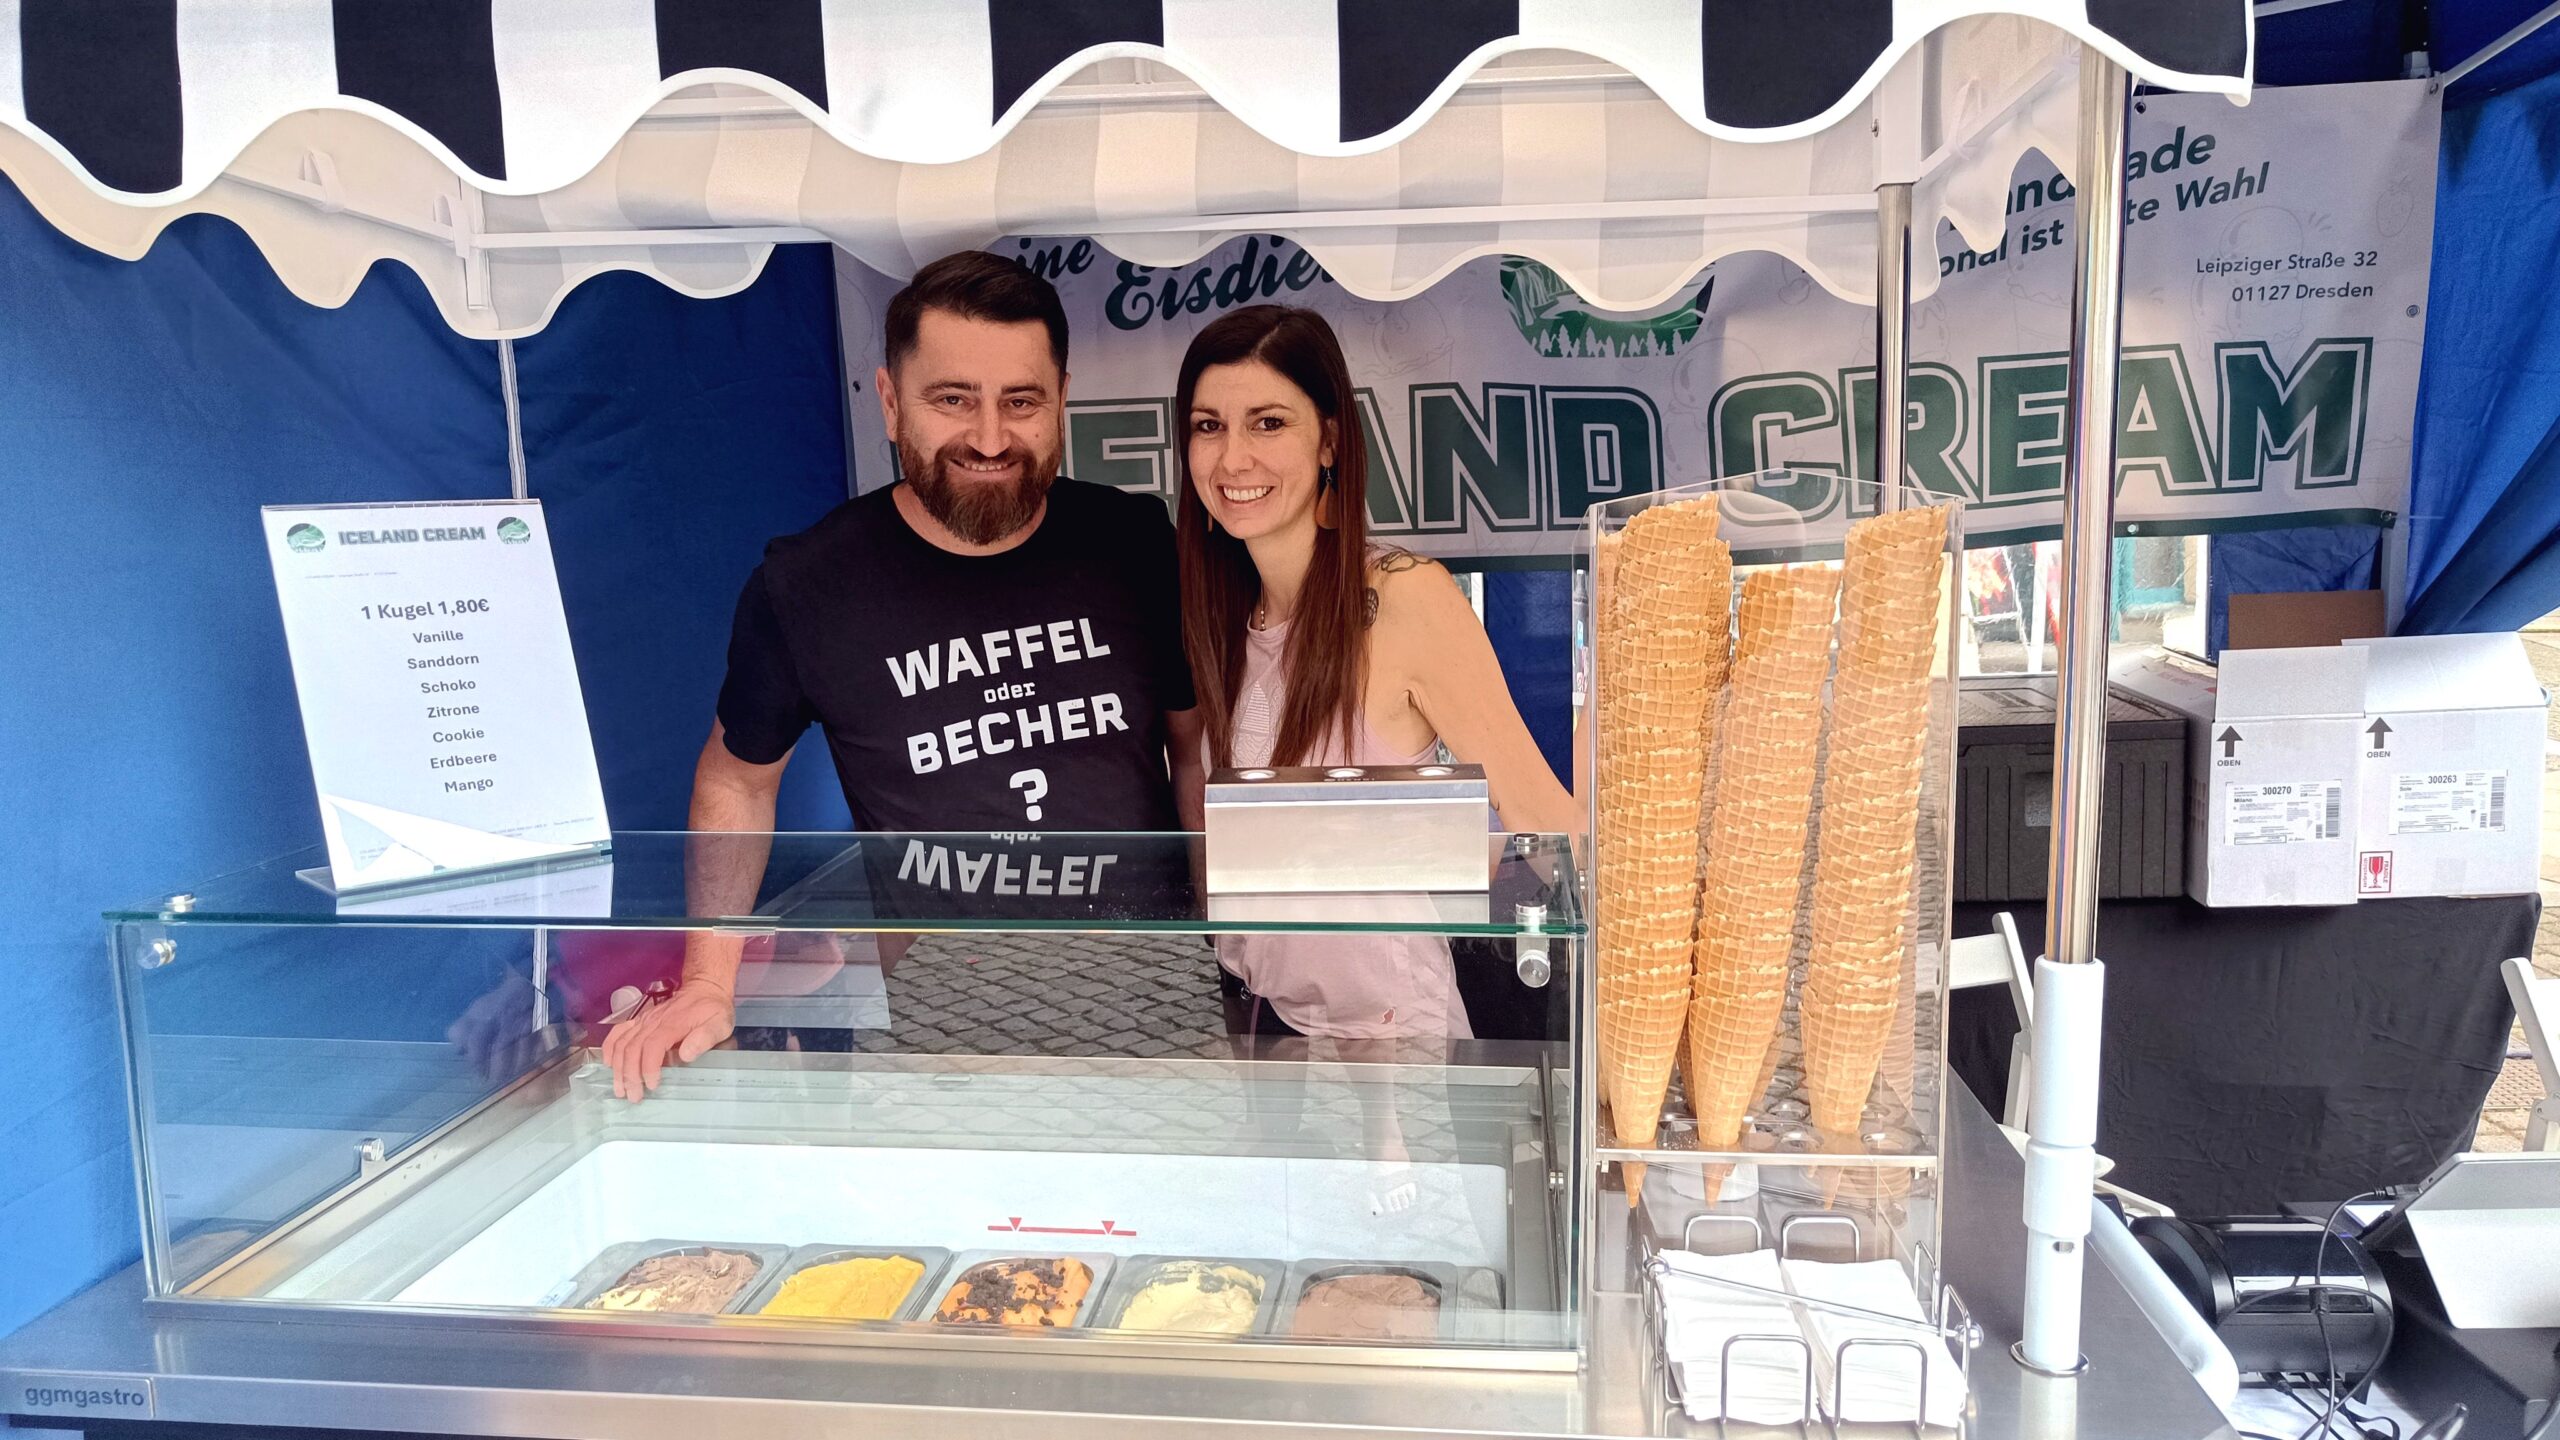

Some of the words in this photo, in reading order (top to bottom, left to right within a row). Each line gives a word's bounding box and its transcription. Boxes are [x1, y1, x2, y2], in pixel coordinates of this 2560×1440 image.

[1940, 229, 2009, 278] onal
[2021, 219, 2065, 255] ist
[2175, 161, 2270, 212] Wahl
[1015, 237, 1096, 279] ine
[2196, 256, 2282, 277] Leipziger
[2287, 251, 2345, 271] Straße
[2353, 250, 2378, 267] 32
[1104, 235, 1334, 331] Eisdie
[2231, 285, 2291, 302] 01127
[2295, 281, 2374, 299] Dresden
[1708, 337, 2373, 527] CREAM
[338, 528, 420, 546] ICELAND
[422, 526, 486, 543] CREAM
[361, 605, 371, 620] 1
[377, 601, 434, 621] Kugel
[437, 598, 490, 617] 1,80€
[412, 630, 464, 644] Vanille
[407, 655, 480, 670] Sanddorn
[885, 617, 1112, 698] WAFFEL
[420, 679, 476, 694] Schoko
[983, 681, 1036, 704] oder
[426, 704, 480, 719] Zitrone
[432, 728, 485, 743] Cookie
[906, 692, 1130, 775] BECHER
[430, 752, 497, 769] Erdbeere
[2216, 759, 2241, 767] OBEN
[2366, 750, 2391, 759] OBEN
[444, 778, 494, 793] Mango
[2427, 774, 2458, 784] 300263
[1009, 768, 1049, 822] ?
[2262, 785, 2292, 796] 300270
[25, 1387, 145, 1408] ggmgastro
